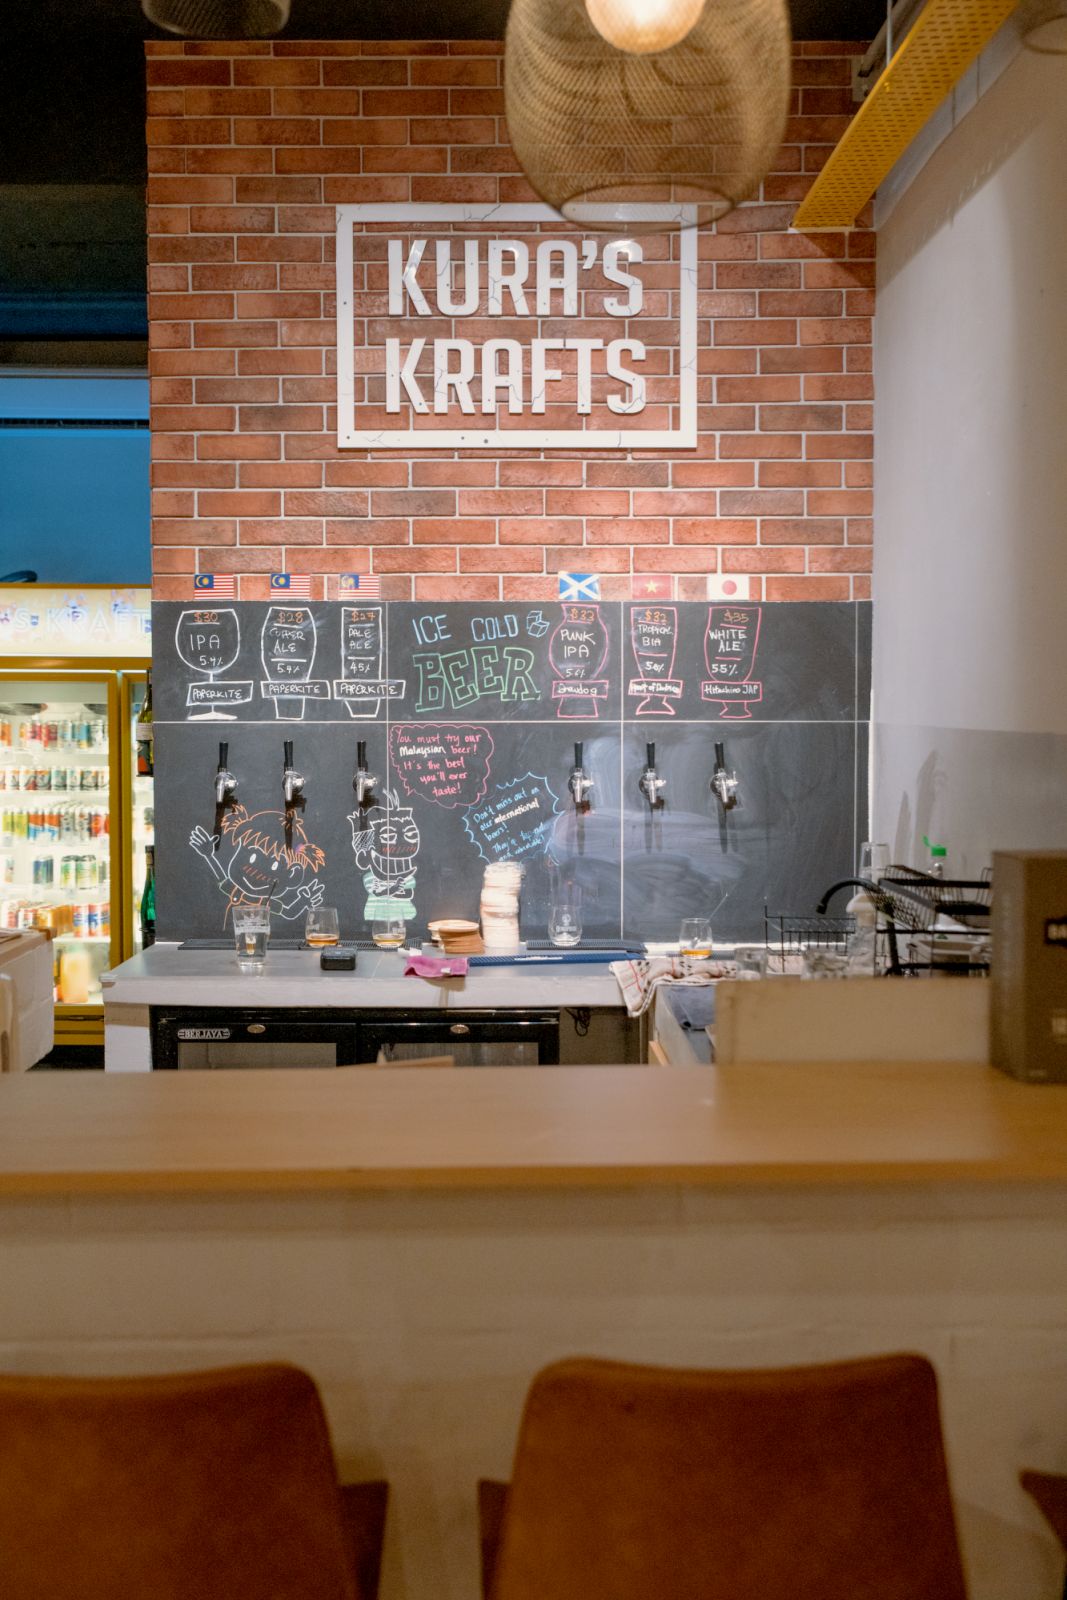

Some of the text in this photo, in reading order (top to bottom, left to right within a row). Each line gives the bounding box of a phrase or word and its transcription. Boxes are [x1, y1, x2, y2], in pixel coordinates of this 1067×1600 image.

[387, 239, 644, 317] KURA'S
[385, 338, 647, 414] KRAFTS
[193, 611, 219, 623] $30
[277, 611, 304, 624] $28
[351, 610, 376, 623] $27
[723, 609, 749, 623] $35
[348, 628, 373, 639] PALE
[412, 614, 519, 645] ICE COLD
[708, 629, 748, 641] WHITE
[190, 634, 221, 651] IPA
[560, 628, 596, 646] PUNK
[273, 639, 297, 655] ALE
[348, 640, 373, 650] ALE
[563, 644, 590, 659] IPA
[718, 639, 741, 653] ALE
[412, 645, 541, 712] BEER
[192, 688, 243, 701] PAPERKITE
[268, 683, 320, 695] PAPERKITE
[340, 682, 398, 696] PAPERKITE
[742, 684, 758, 695] JAP
[395, 729, 481, 747] You must try our
[399, 743, 477, 758] Malaysian beer!
[427, 760, 440, 770] the
[445, 756, 465, 768] best
[419, 771, 446, 784] you'll
[432, 782, 462, 796] taste!
[184, 1029, 223, 1040] BERJAYA
